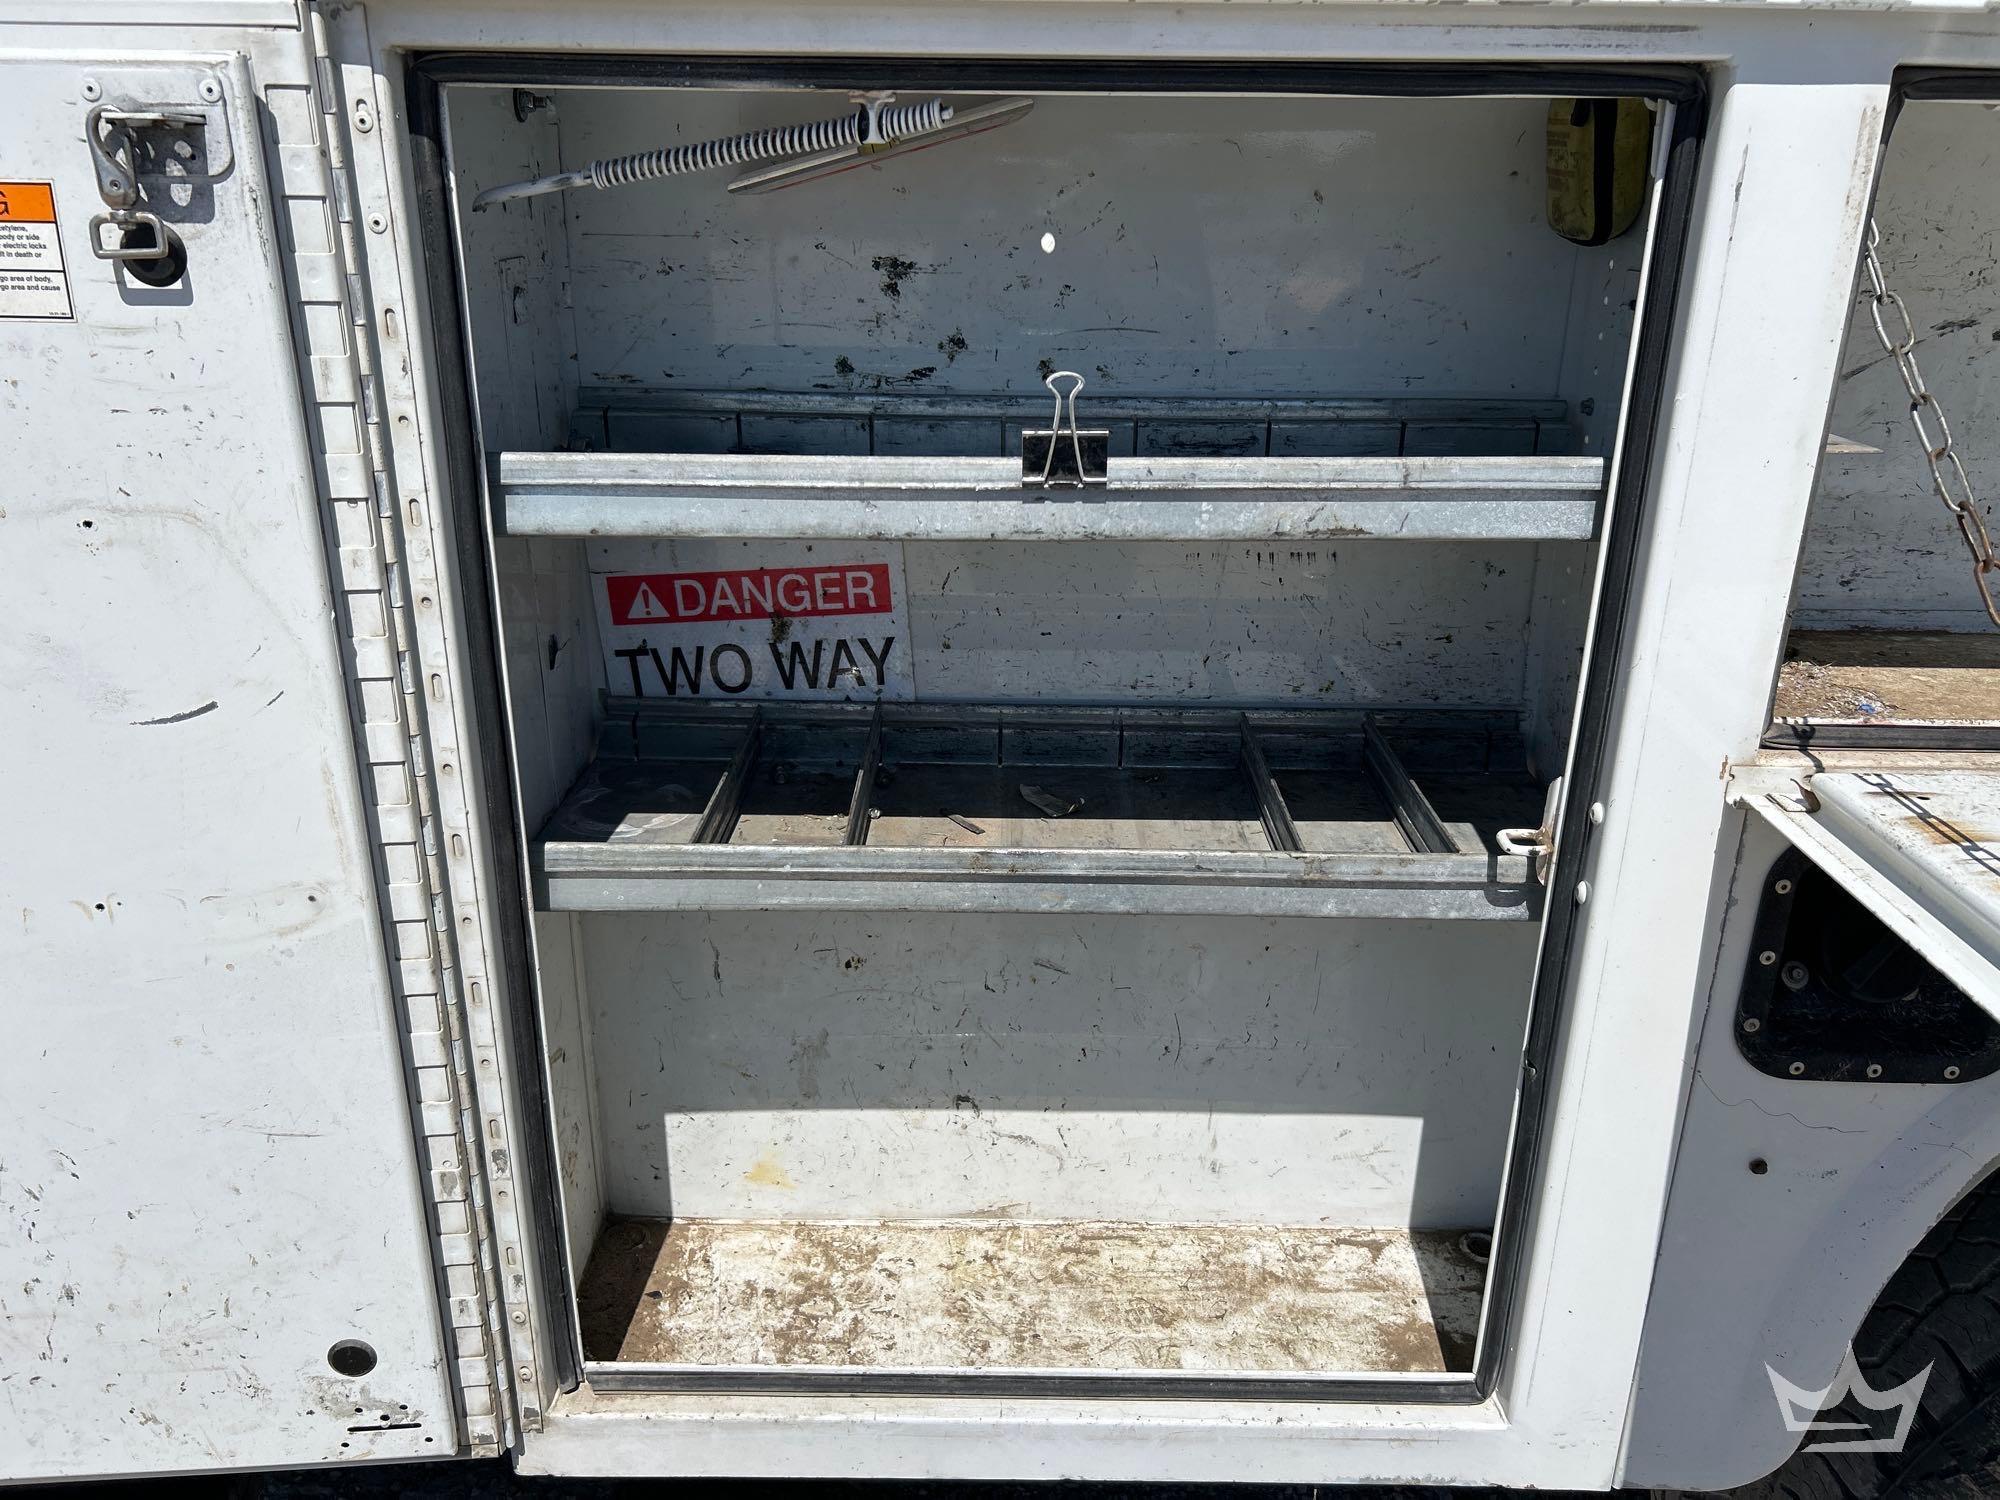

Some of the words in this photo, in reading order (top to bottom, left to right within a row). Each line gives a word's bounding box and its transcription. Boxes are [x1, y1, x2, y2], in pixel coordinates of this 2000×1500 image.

[673, 571, 877, 617] DANGER
[615, 643, 753, 697] TWO
[769, 636, 896, 690] WAY
